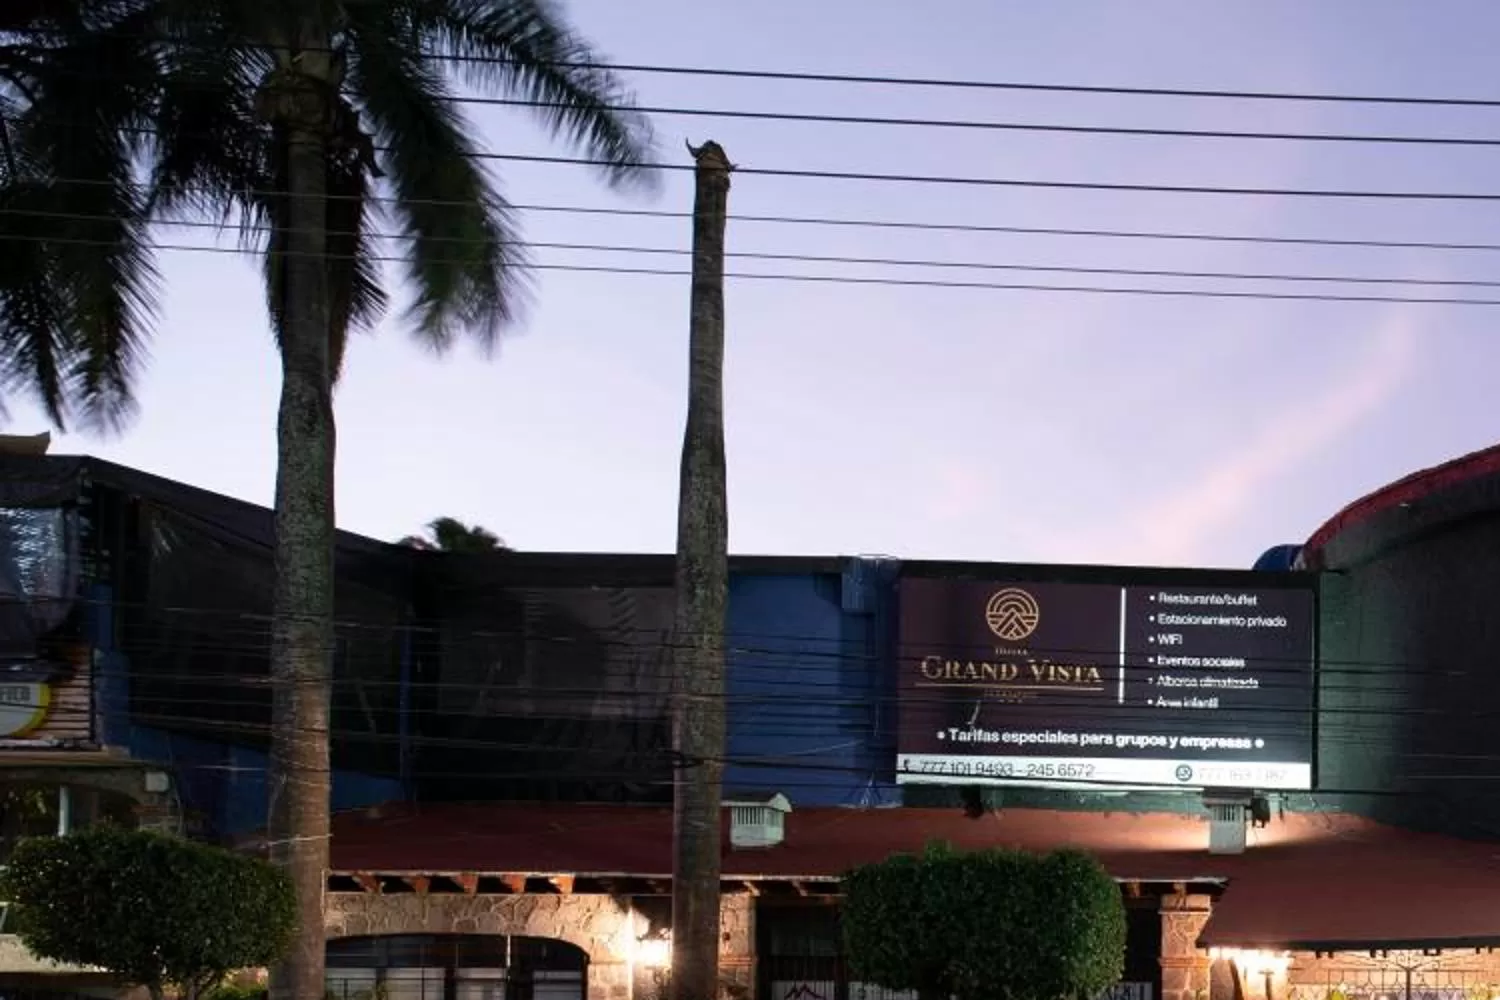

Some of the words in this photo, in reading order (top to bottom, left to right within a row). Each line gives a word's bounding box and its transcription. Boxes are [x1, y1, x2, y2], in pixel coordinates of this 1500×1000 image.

[1157, 613, 1245, 625] Estacionamiento
[1247, 616, 1287, 628] privado
[921, 655, 1018, 682] GRAND
[1027, 658, 1104, 684] VISTA
[1157, 655, 1201, 667] Eventos
[1202, 656, 1245, 668] sociales
[1183, 696, 1219, 708] infantil
[948, 728, 1000, 744] Tarifas
[1002, 730, 1078, 746] especiales
[1080, 733, 1114, 747] para
[1116, 734, 1167, 749] grupos
[1169, 736, 1179, 749] y
[1180, 737, 1252, 750] empresas
[920, 760, 947, 774] 777
[950, 761, 972, 775] 101
[1027, 763, 1054, 777] 245
[1057, 763, 1096, 778] 6572
